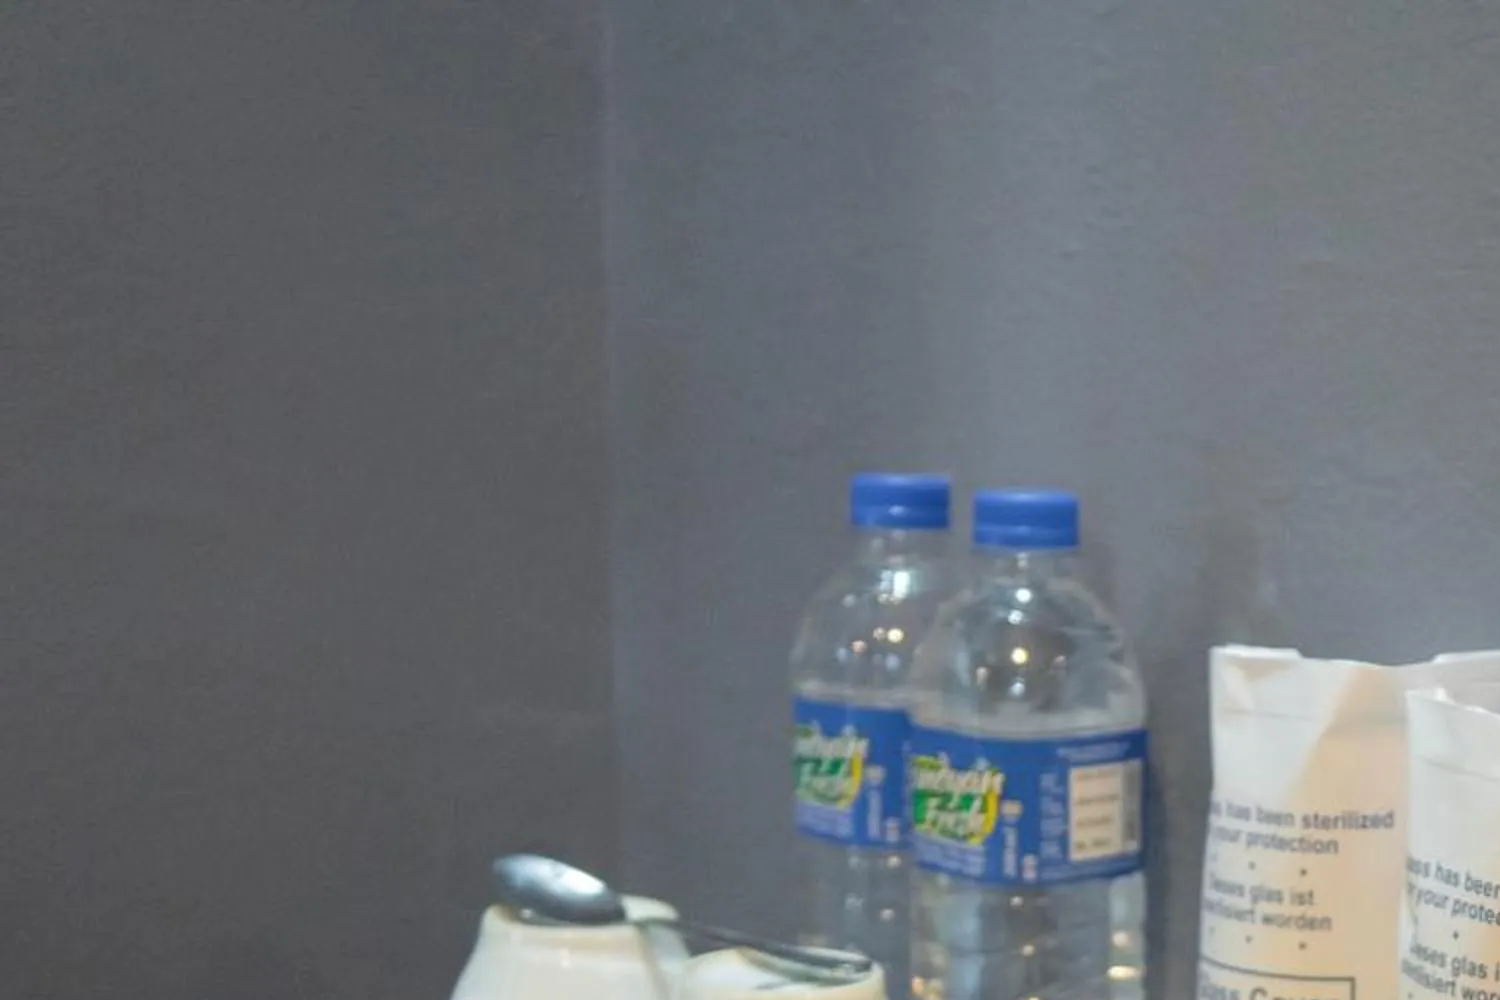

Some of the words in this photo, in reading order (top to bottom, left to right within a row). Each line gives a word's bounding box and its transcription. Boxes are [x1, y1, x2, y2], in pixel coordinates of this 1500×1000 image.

[1302, 810, 1396, 831] sterilized
[1246, 831, 1340, 855] protection
[1435, 860, 1460, 888] has
[1261, 911, 1333, 932] worden
[1451, 955, 1488, 979] glas
